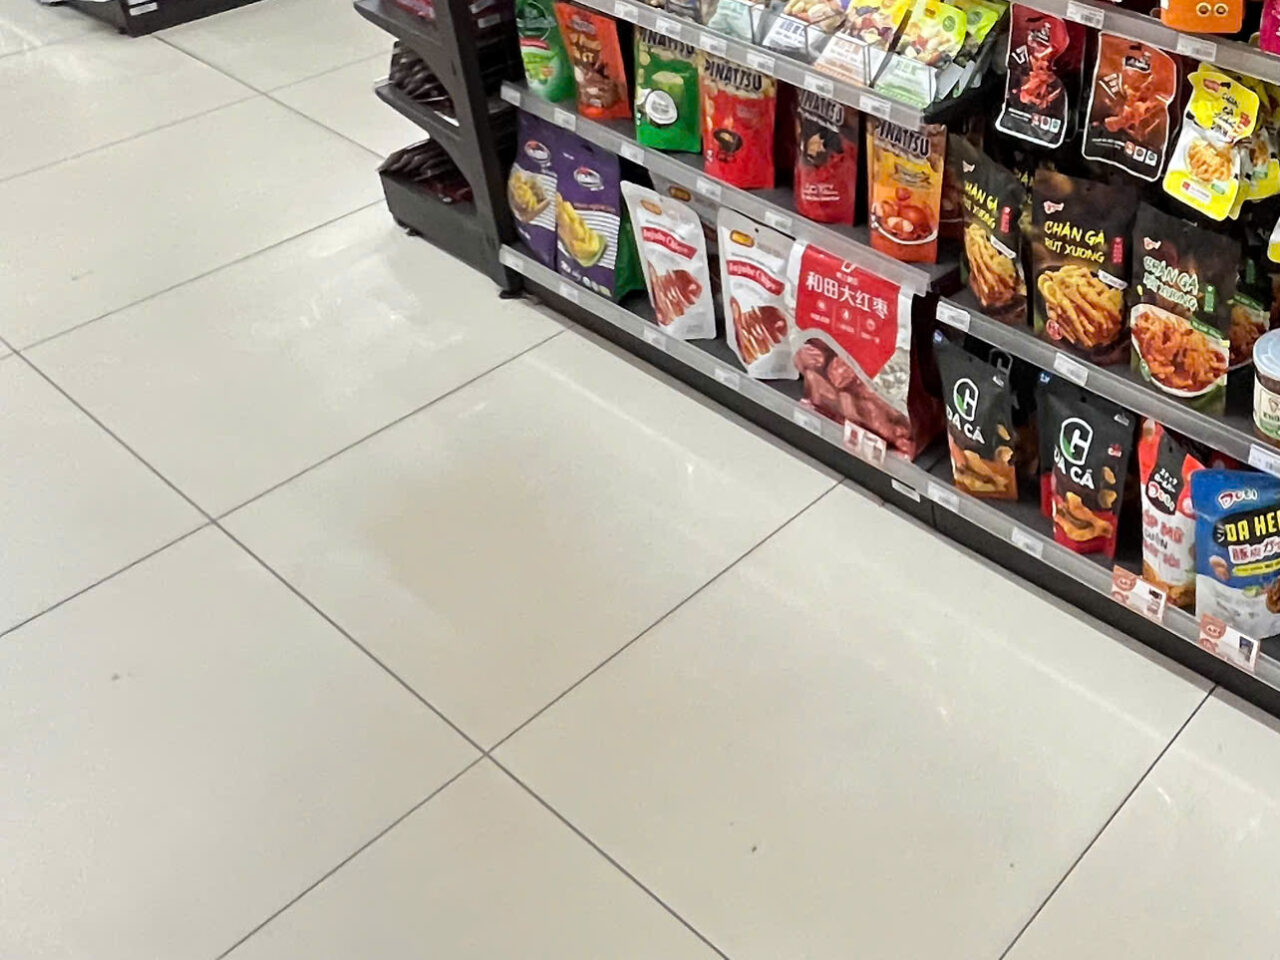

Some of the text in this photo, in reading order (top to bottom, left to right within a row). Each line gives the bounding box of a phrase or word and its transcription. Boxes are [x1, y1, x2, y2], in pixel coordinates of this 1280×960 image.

[805, 270, 889, 320] 和田大红枣
